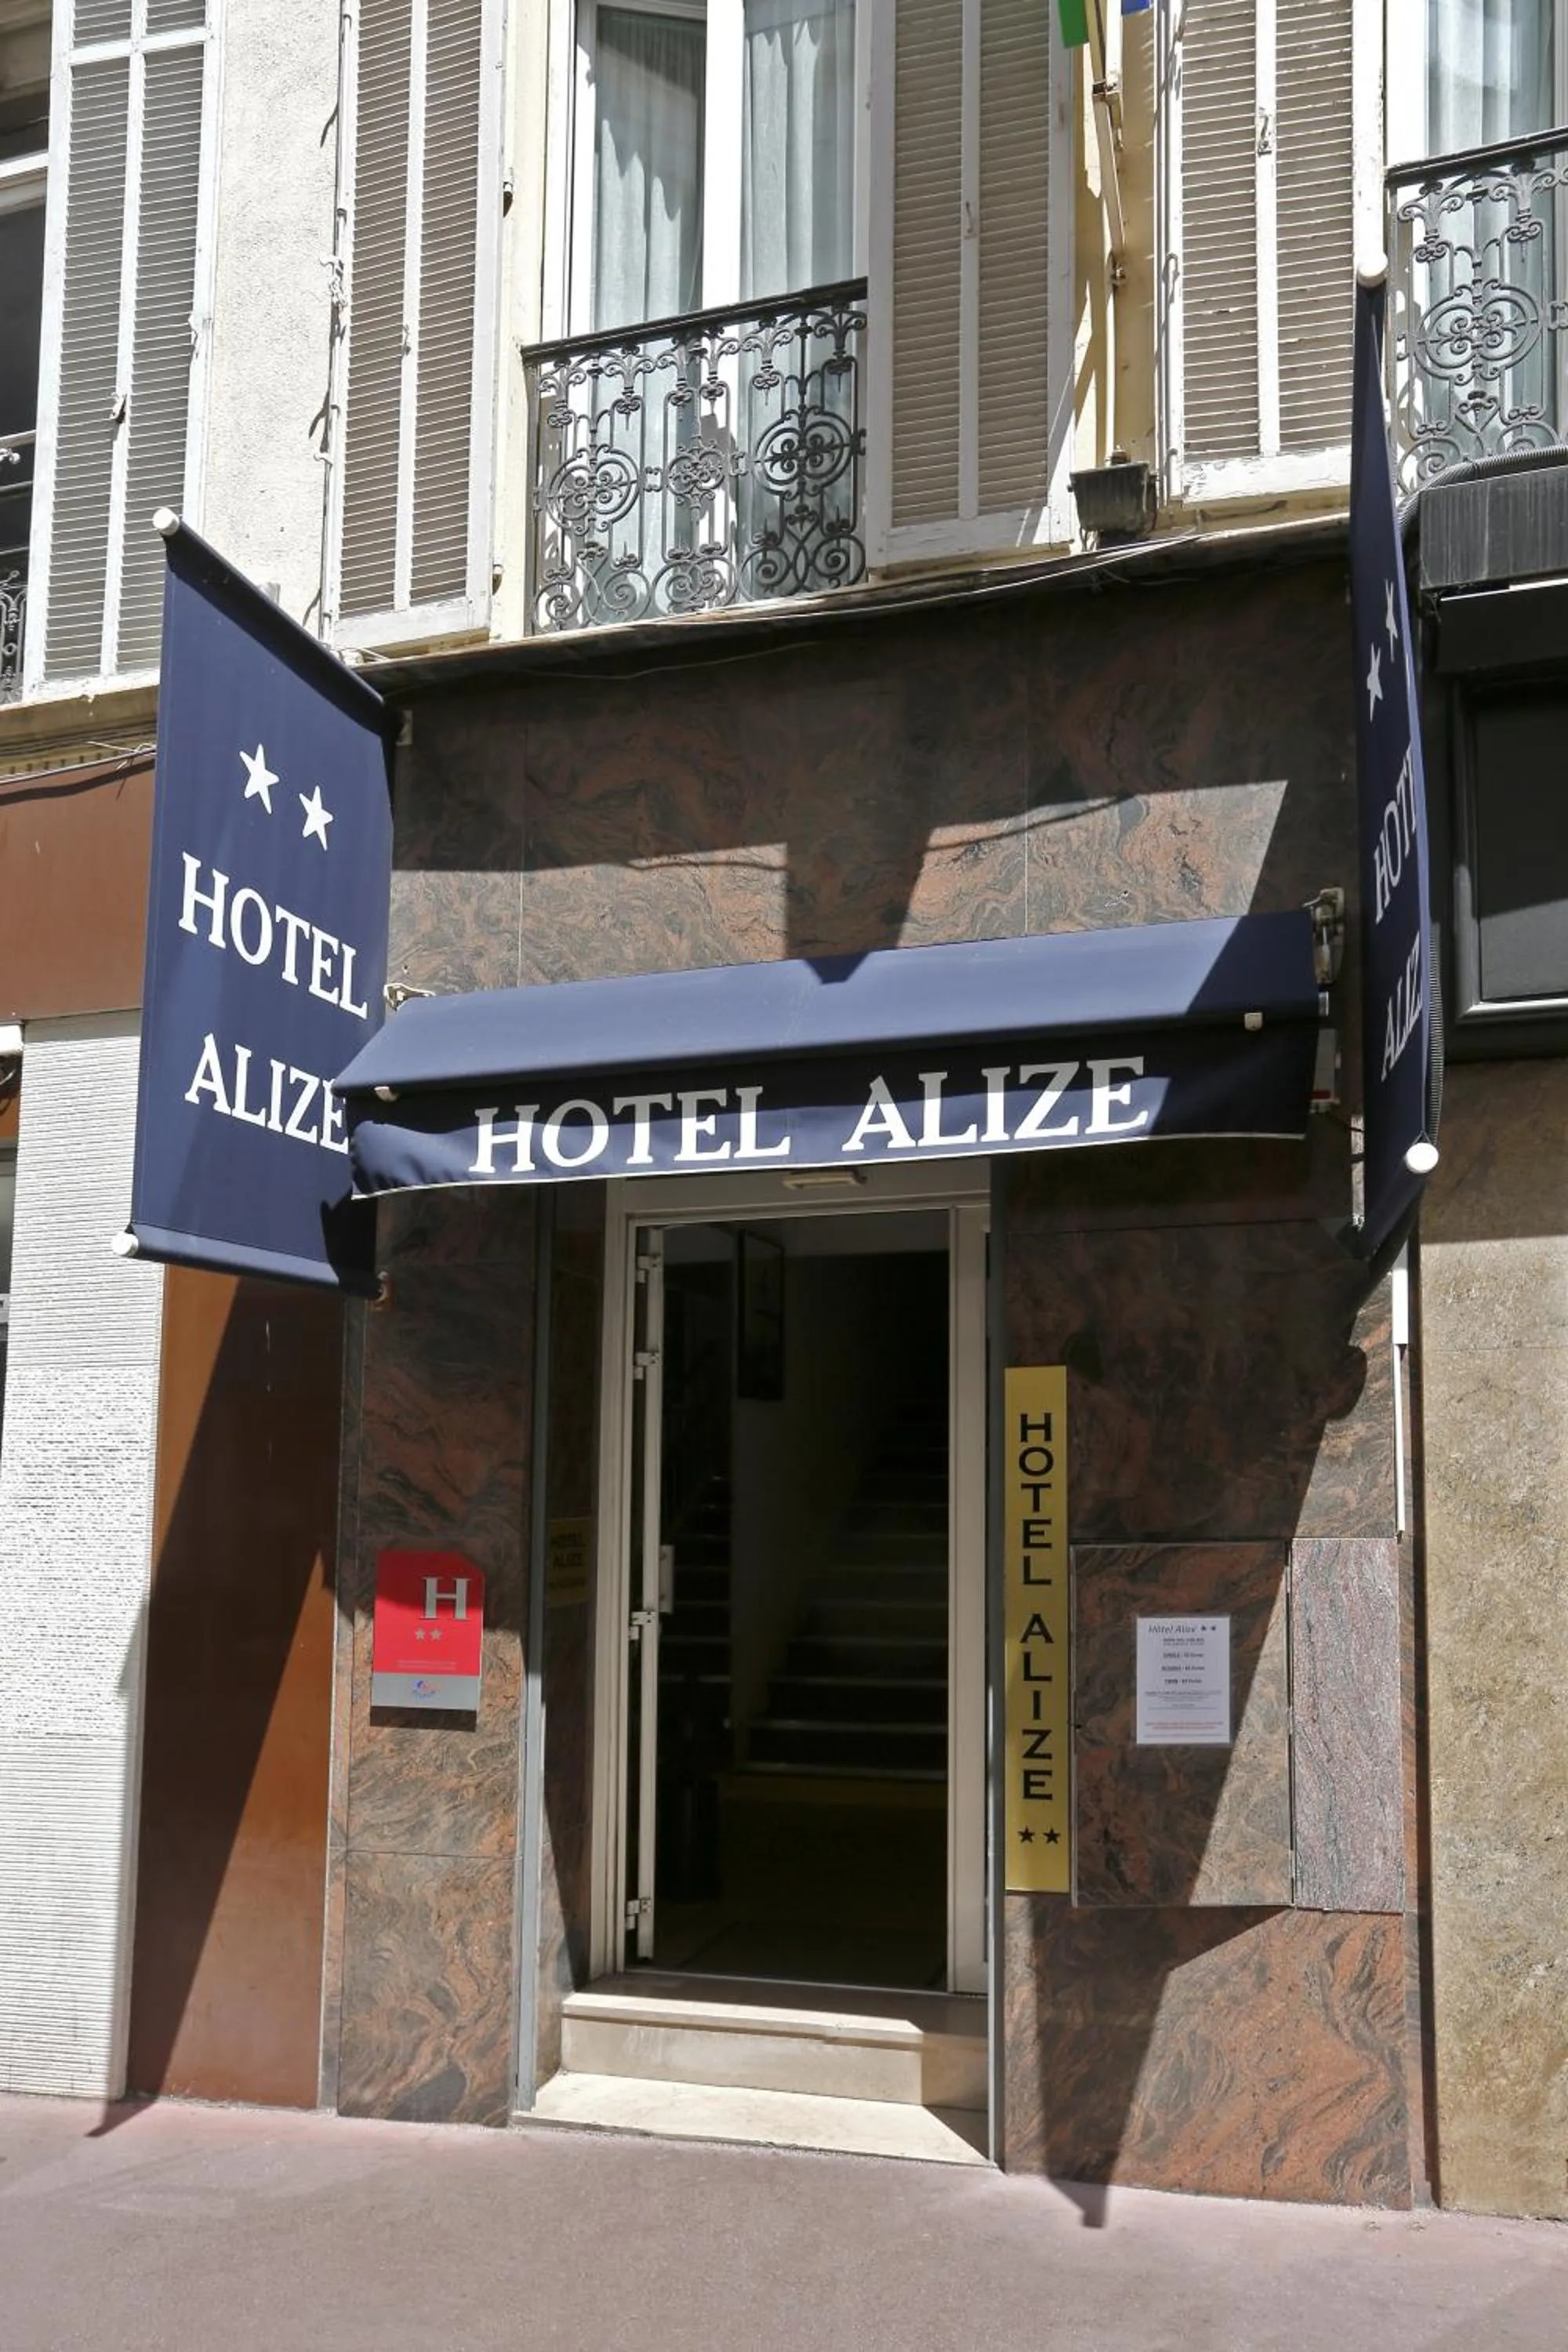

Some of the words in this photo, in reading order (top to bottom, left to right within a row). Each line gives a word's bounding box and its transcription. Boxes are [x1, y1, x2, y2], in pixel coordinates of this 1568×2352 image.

[178, 851, 368, 1019] HOTEL
[184, 1033, 349, 1154] ALIZE
[468, 1085, 791, 1174] HOTEL
[842, 1056, 1149, 1151] ALIZE
[1018, 1412, 1054, 1585] HOTEL
[419, 1576, 471, 1621] H
[1019, 1613, 1054, 1800] ALIZE
